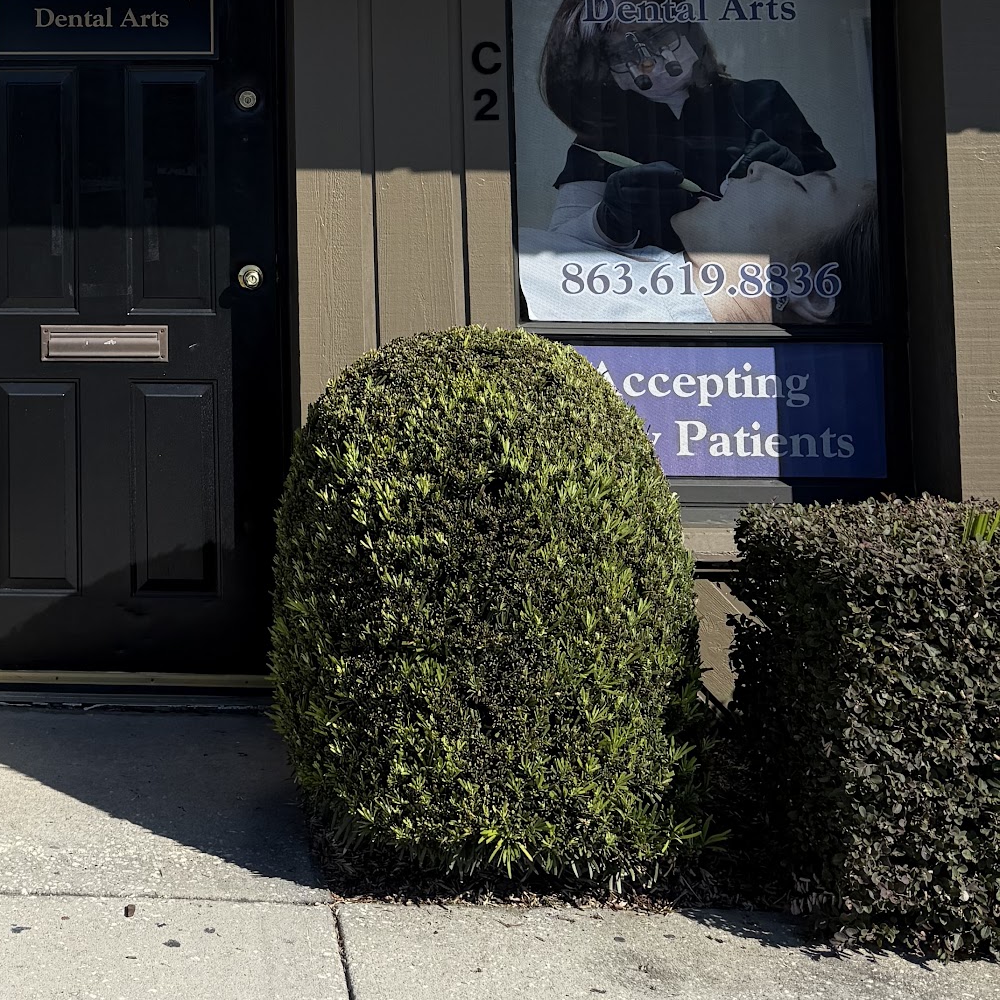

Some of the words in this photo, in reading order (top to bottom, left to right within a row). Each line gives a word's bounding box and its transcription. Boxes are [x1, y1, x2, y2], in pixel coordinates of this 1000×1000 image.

[34, 7, 113, 28] Dental
[119, 8, 169, 28] Arts
[560, 262, 842, 297] 863.619.8836
[675, 420, 855, 458] Patients
